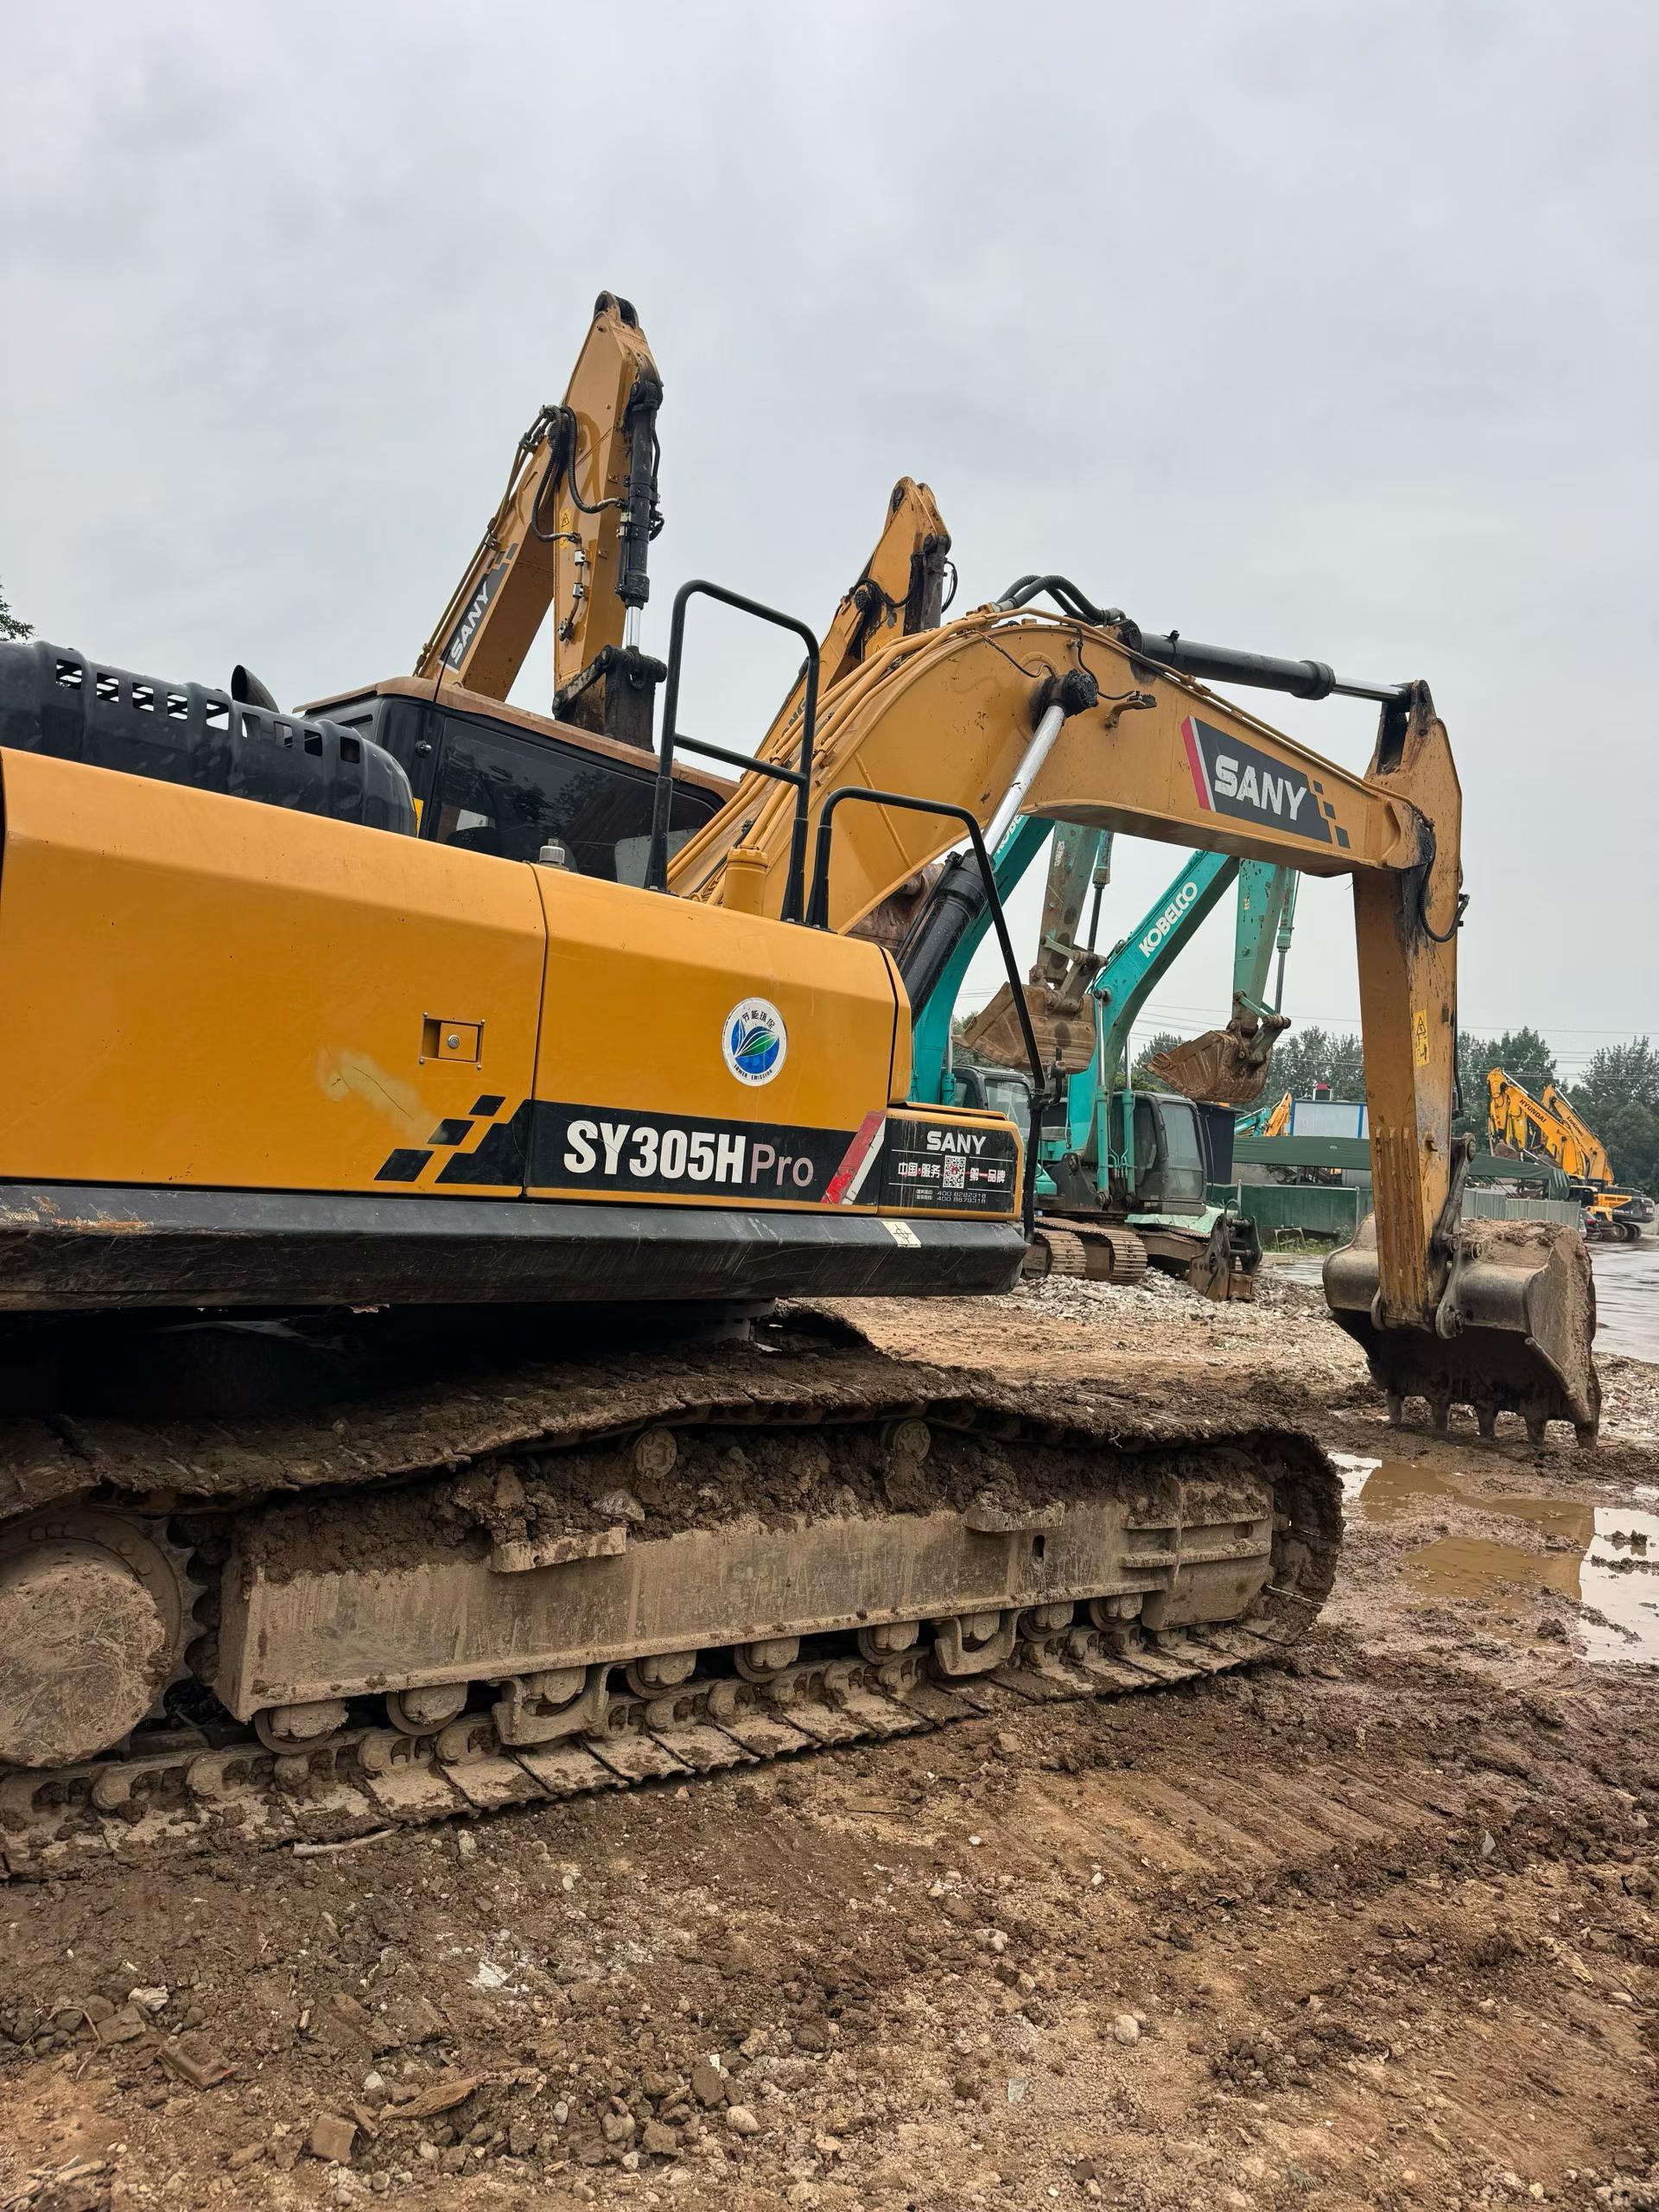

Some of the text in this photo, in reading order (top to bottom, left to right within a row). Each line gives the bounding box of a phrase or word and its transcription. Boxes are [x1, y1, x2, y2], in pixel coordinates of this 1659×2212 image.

[451, 581, 489, 664] SANY
[1214, 754, 1307, 821] SANY
[1139, 881, 1198, 958] KOBELCO
[926, 1130, 987, 1155] SANY
[1520, 1098, 1547, 1123] HYUNDAI
[563, 1120, 814, 1187] SY305H Pro
